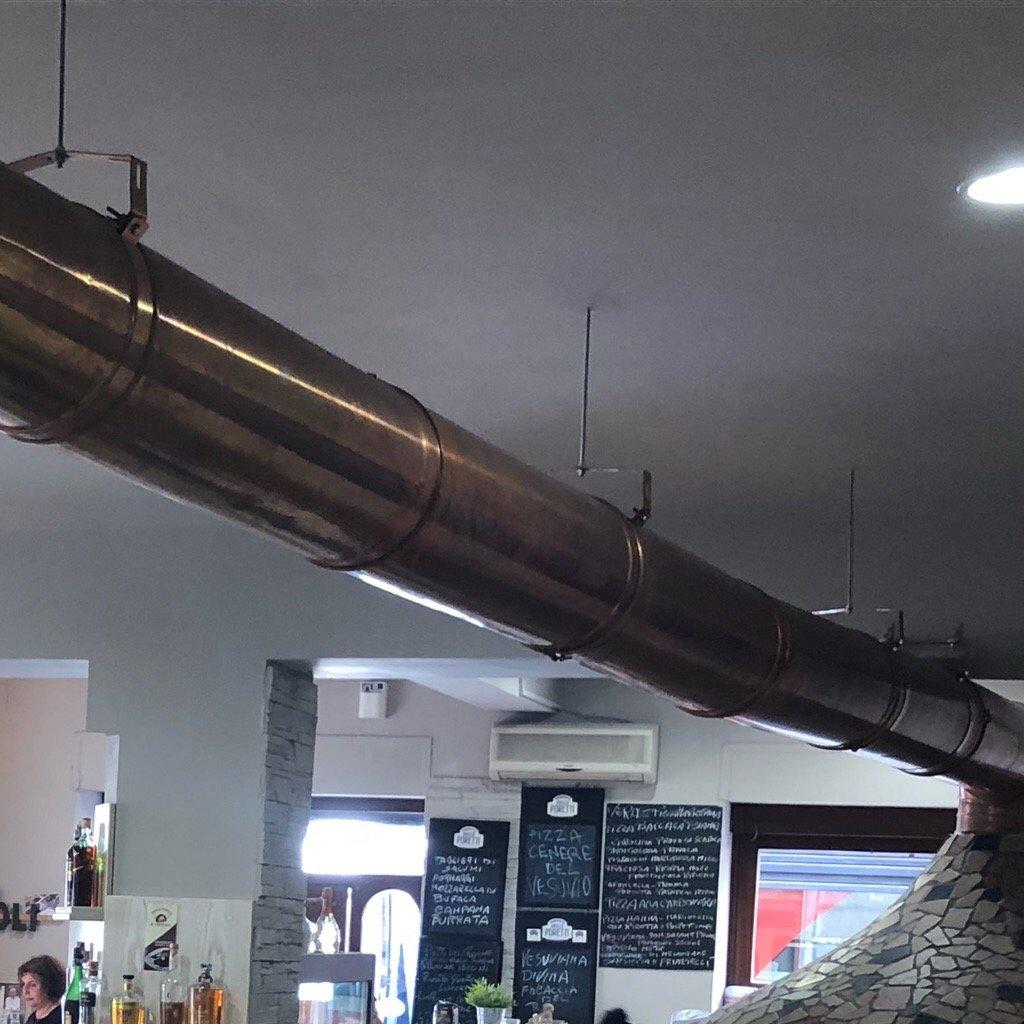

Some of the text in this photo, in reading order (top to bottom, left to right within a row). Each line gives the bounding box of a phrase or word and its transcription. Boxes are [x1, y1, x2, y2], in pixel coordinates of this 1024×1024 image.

[528, 828, 582, 843] PIZZA
[528, 843, 592, 862] CENERE
[545, 862, 580, 875] DEL
[432, 893, 476, 903] BUFALA
